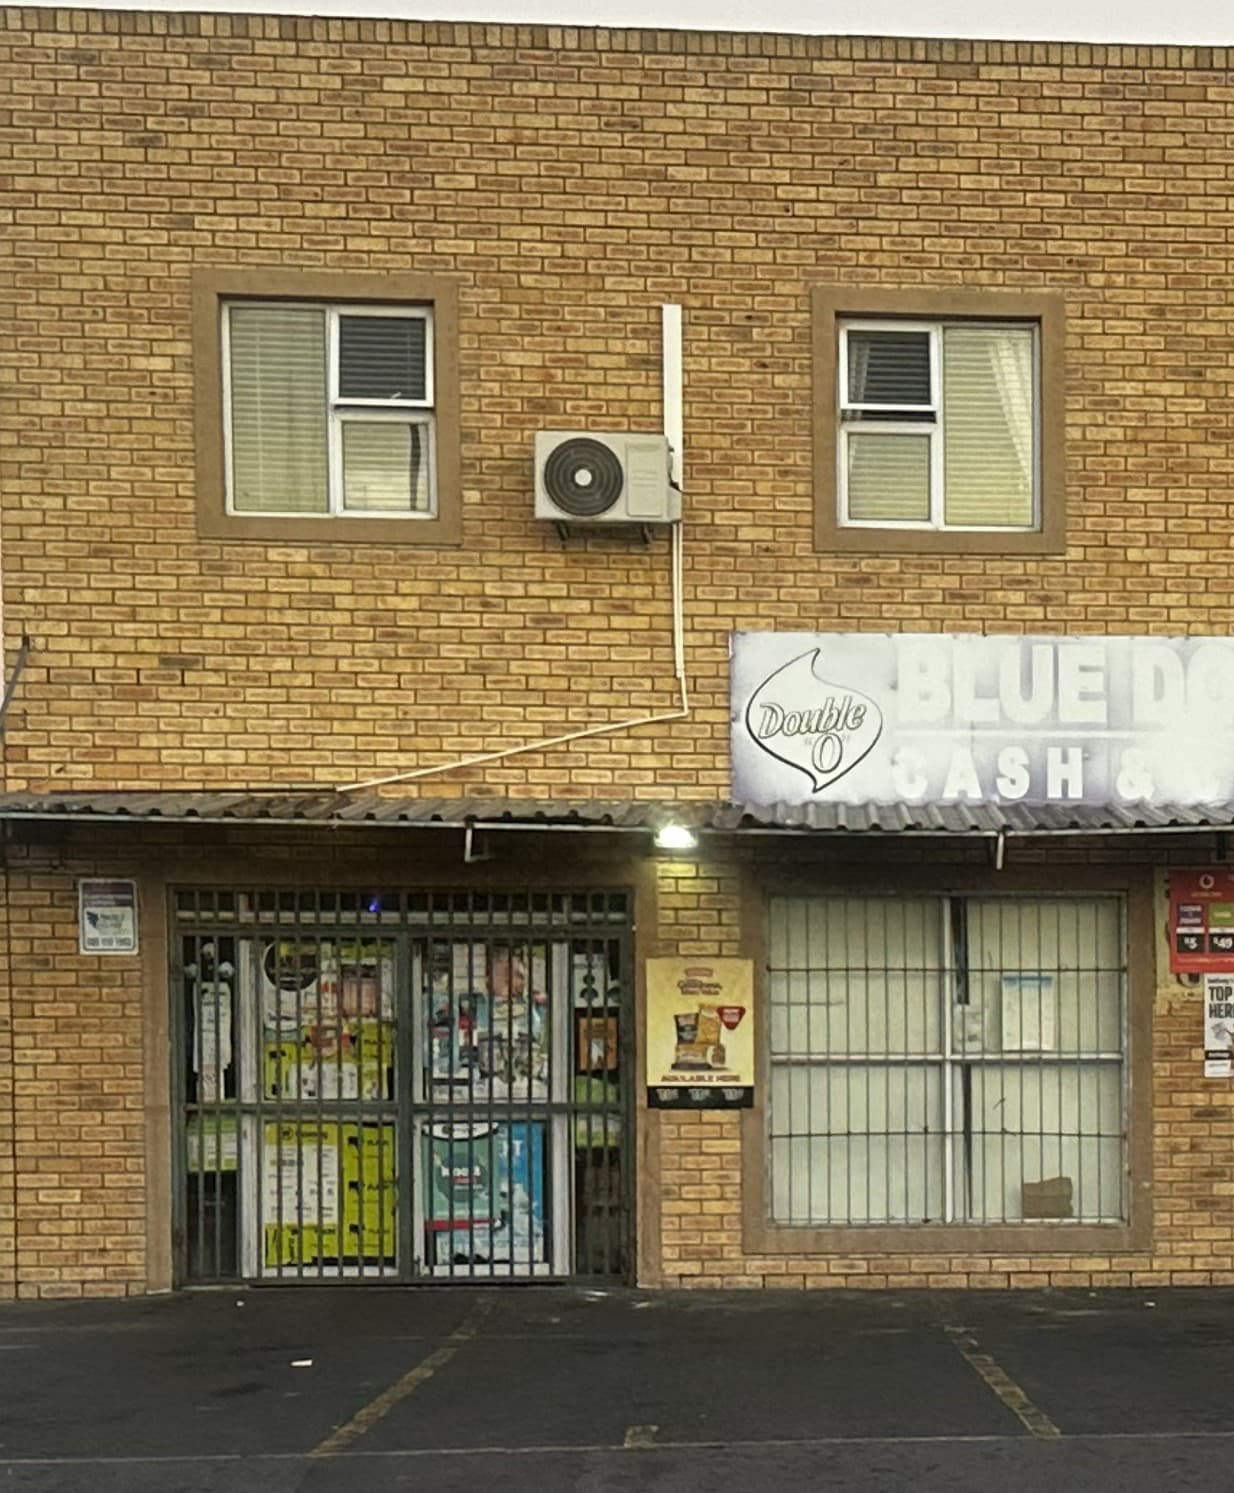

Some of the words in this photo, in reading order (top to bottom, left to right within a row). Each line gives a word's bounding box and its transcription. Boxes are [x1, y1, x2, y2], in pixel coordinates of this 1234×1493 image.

[896, 642, 1107, 725] BLUE
[757, 697, 867, 740] Double
[893, 745, 1084, 800] CASH
[1116, 748, 1156, 801] &
[1208, 986, 1232, 1001] TOP
